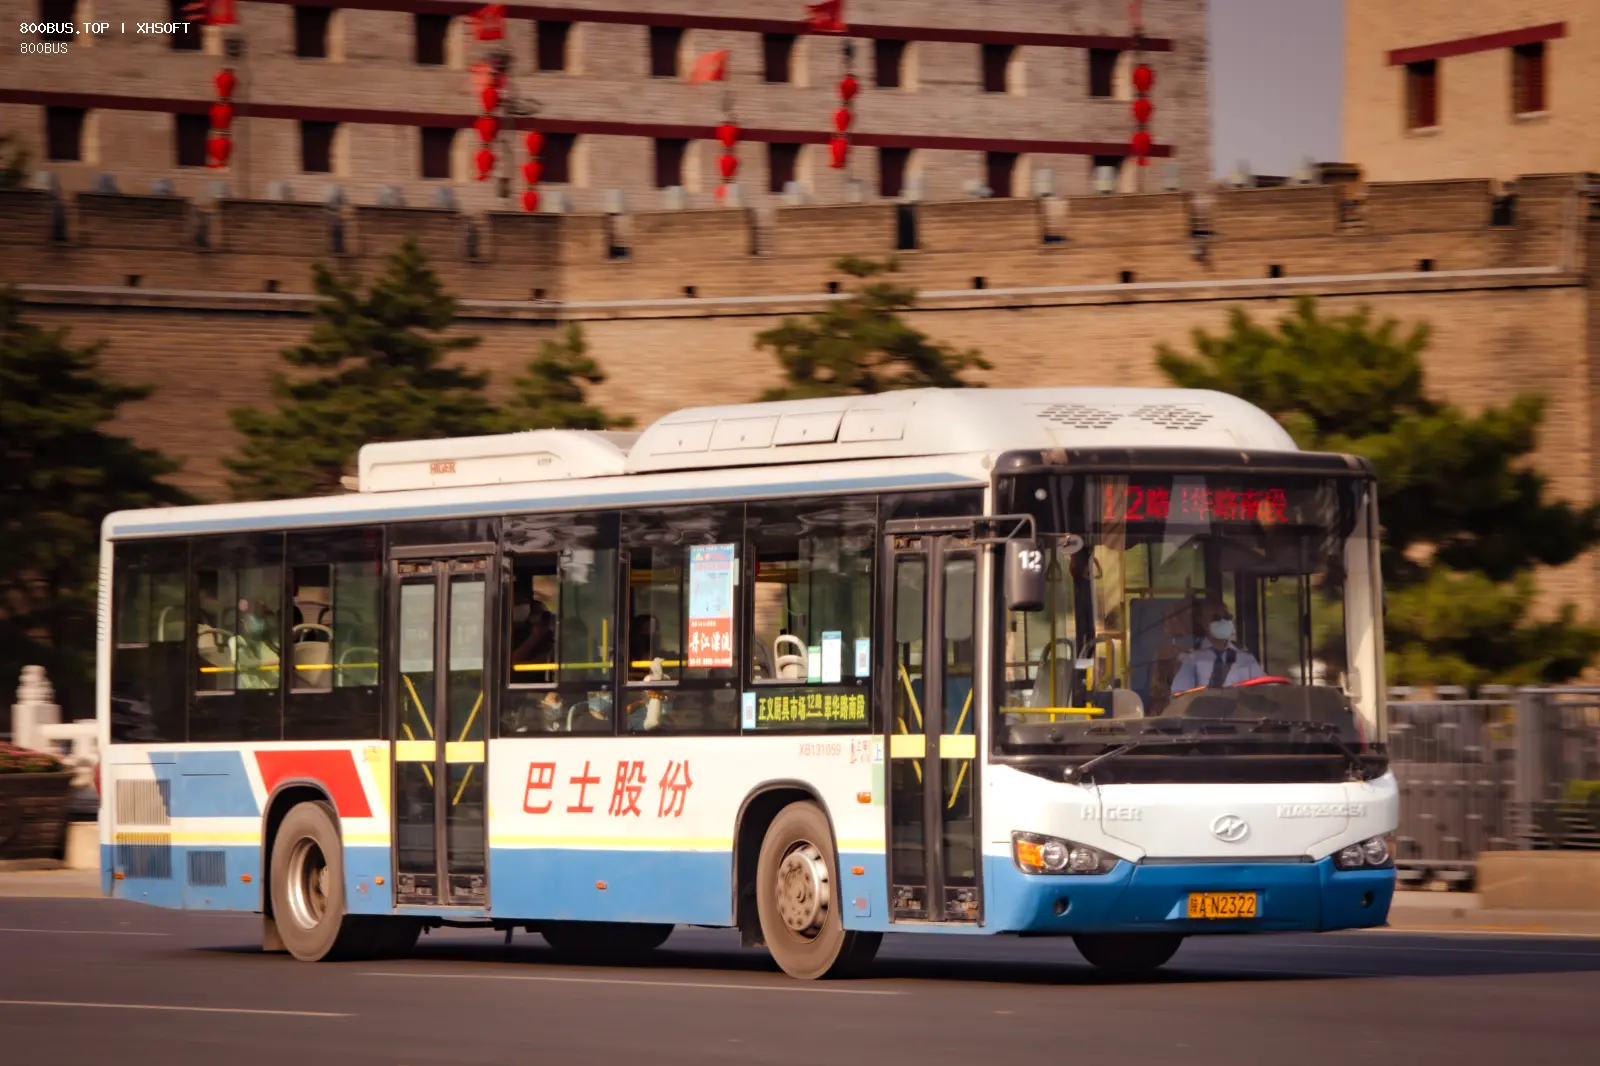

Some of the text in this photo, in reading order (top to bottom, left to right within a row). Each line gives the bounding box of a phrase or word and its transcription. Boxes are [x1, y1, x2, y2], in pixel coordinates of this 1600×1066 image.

[1018, 550, 1042, 572] 12
[522, 759, 694, 819] 巴士股份
[1080, 804, 1142, 821] HIGER
